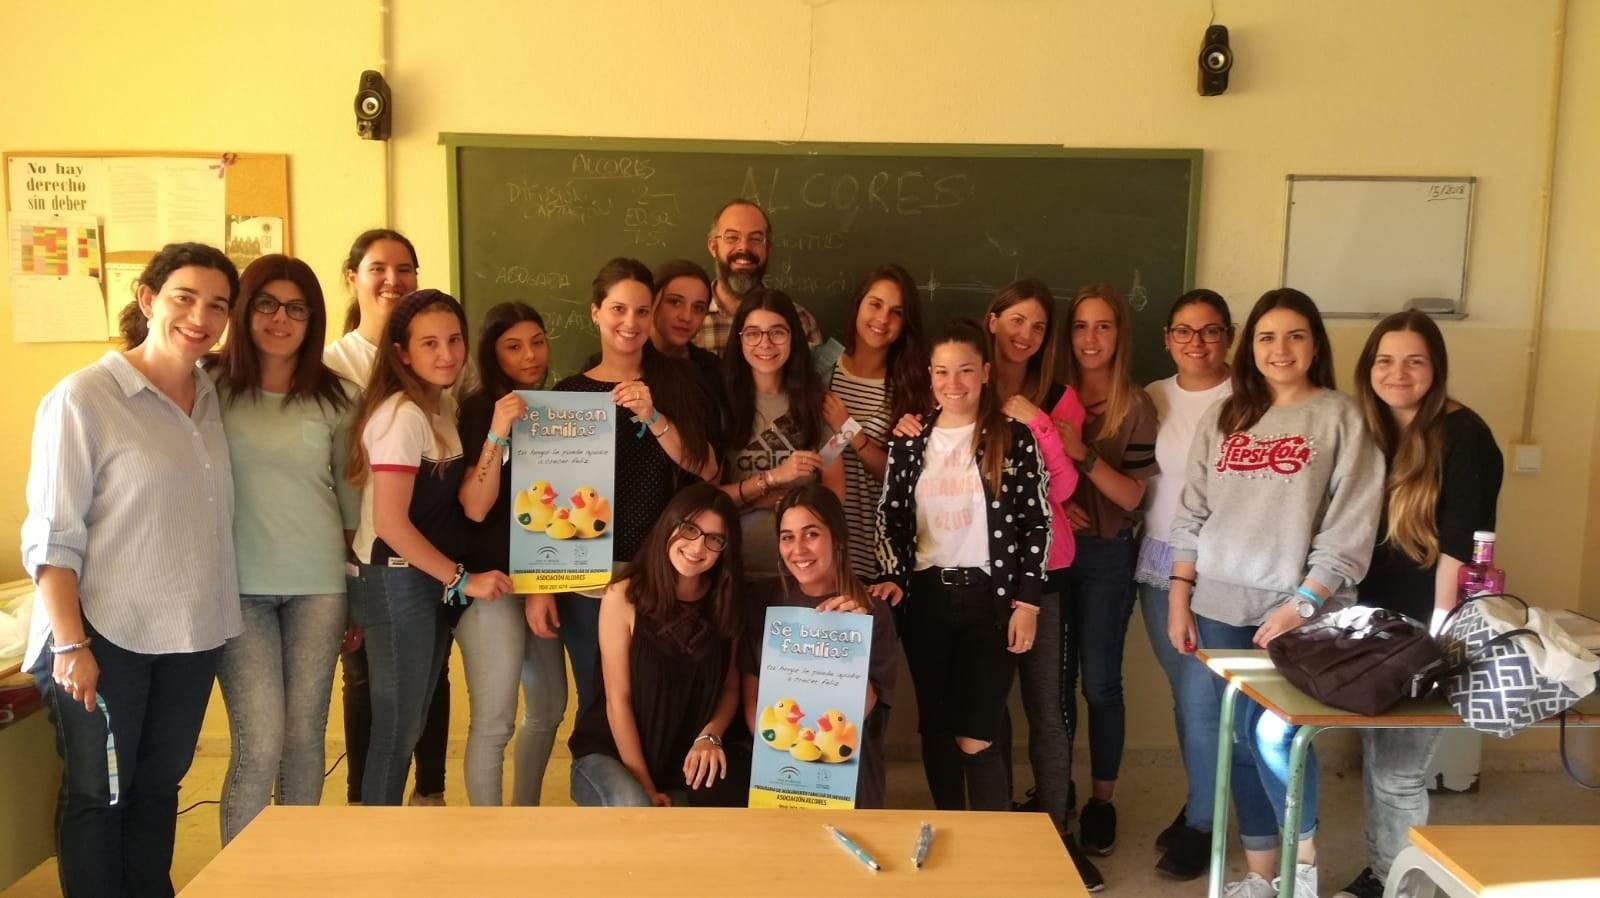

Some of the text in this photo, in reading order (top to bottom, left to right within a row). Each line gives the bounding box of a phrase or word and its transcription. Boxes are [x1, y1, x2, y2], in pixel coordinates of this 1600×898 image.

[28, 162, 84, 176] No hay
[26, 177, 87, 192] derecho
[740, 164, 970, 215] ALCORES
[28, 194, 88, 211] sin deber
[547, 407, 608, 422] buscan
[530, 422, 597, 438] familias
[770, 620, 863, 643] Se buscan
[781, 638, 849, 658] familias
